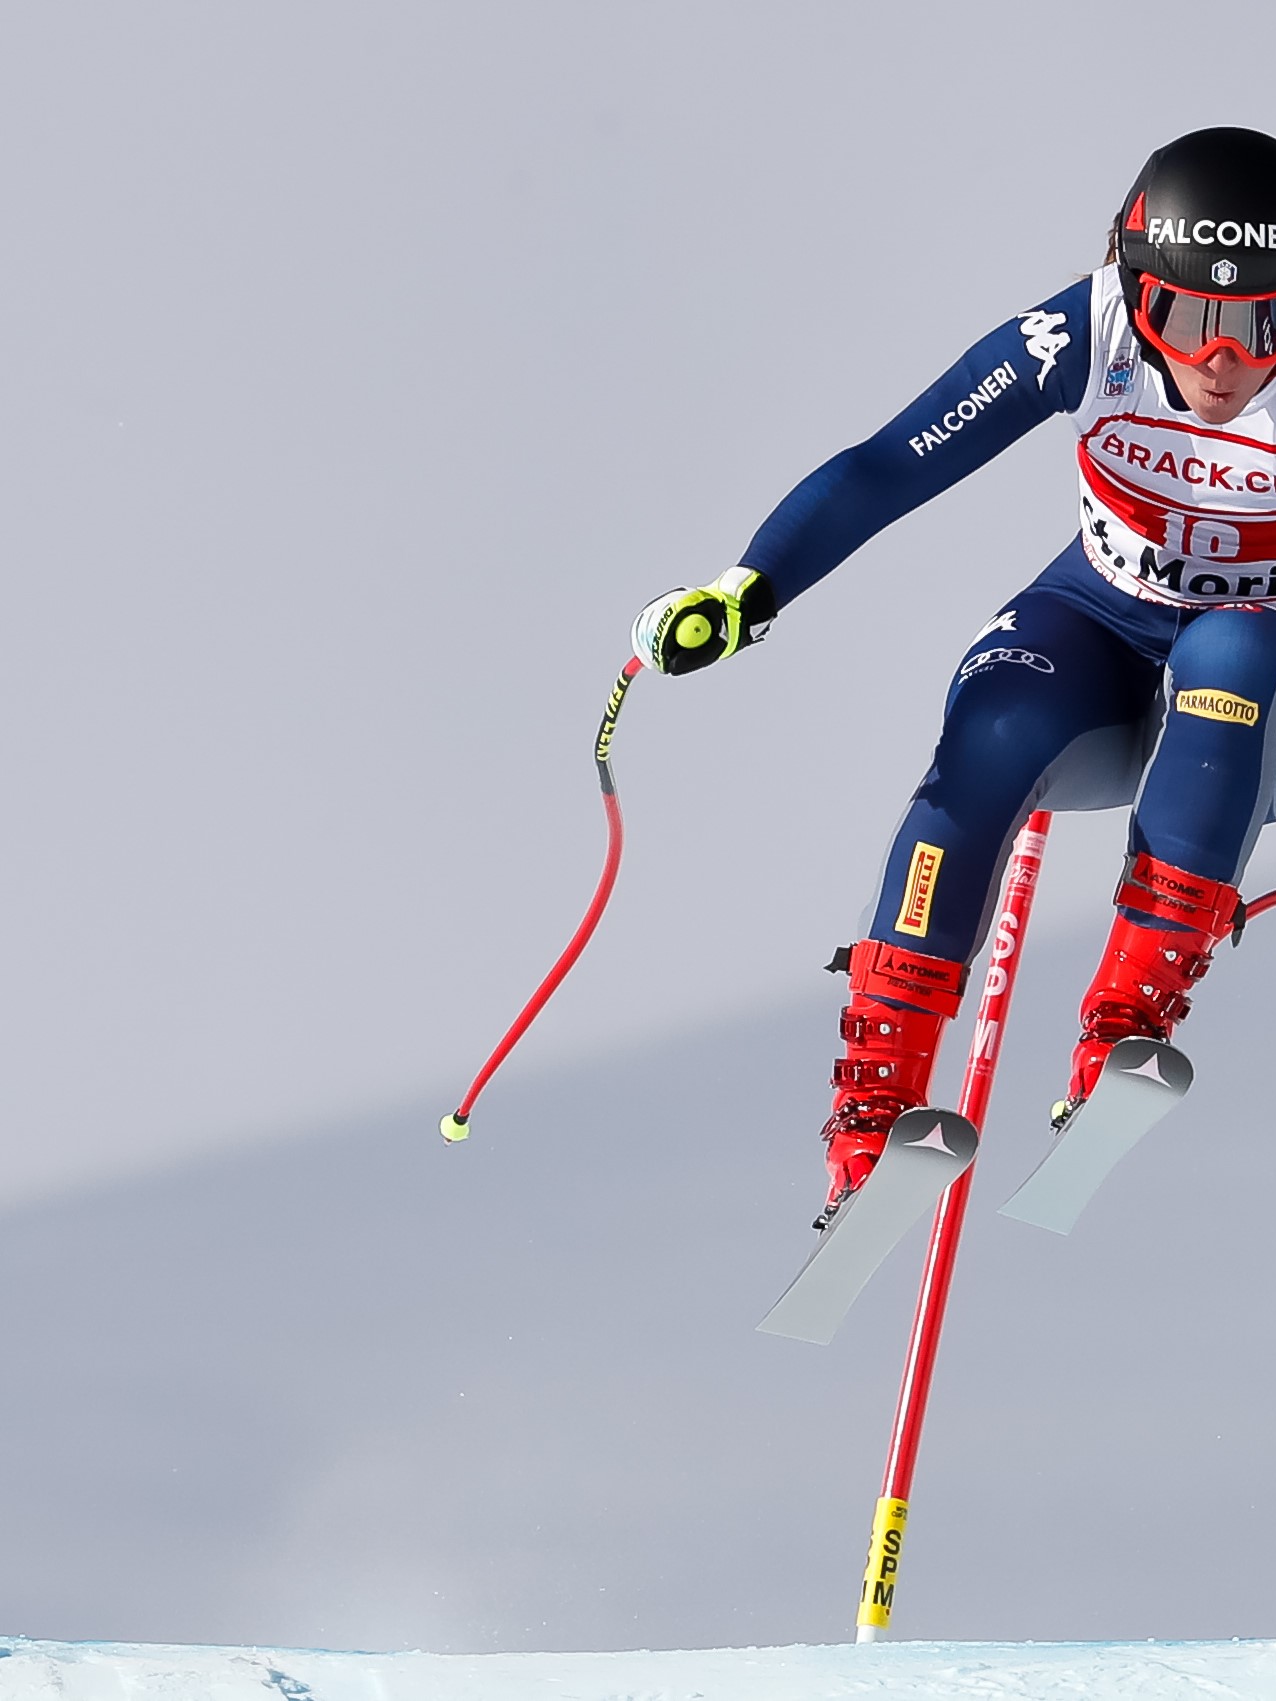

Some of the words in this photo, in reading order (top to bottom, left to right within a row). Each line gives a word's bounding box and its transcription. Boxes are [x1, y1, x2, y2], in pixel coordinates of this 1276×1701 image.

[908, 360, 1018, 457] FALCONERI
[1180, 695, 1256, 721] PARMACOTTO
[903, 851, 936, 928] PIRELLI
[1150, 873, 1205, 899] ATOMIC
[896, 962, 950, 982] ATOMIC
